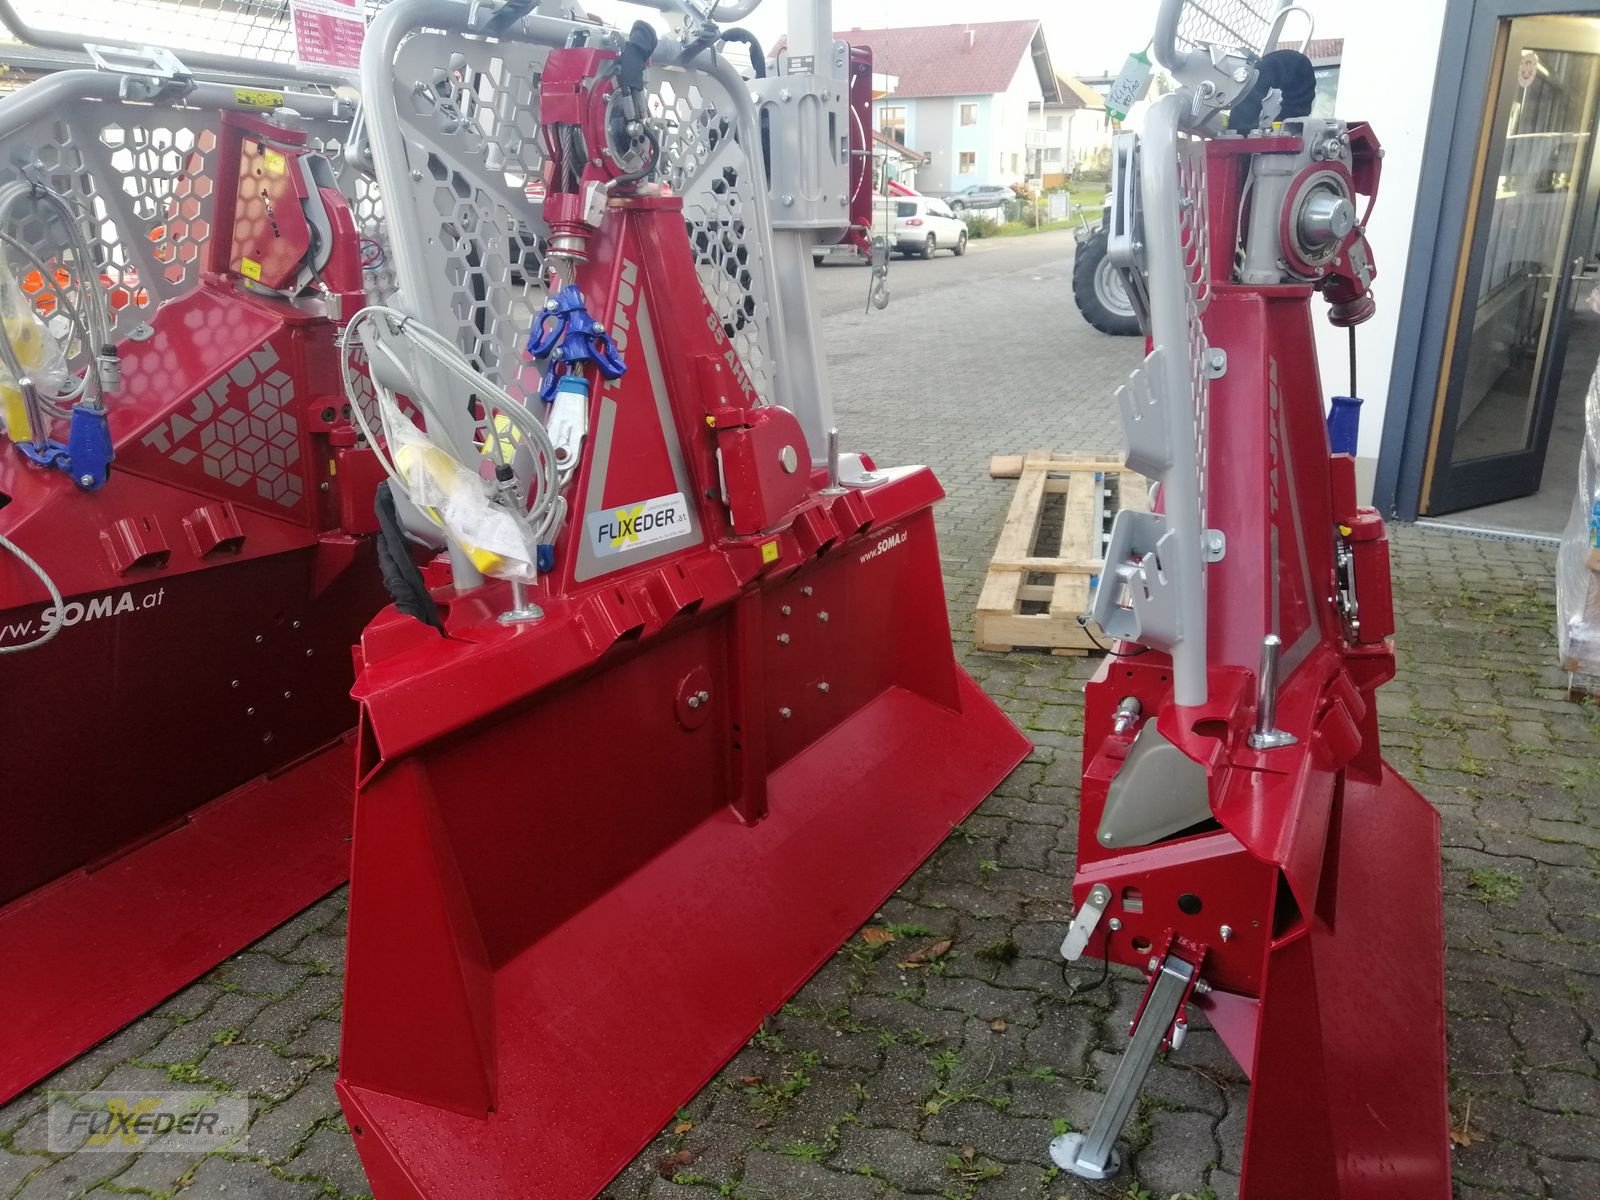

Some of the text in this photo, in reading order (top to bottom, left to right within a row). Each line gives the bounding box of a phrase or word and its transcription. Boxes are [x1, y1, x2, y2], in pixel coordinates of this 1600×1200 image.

[140, 340, 280, 454] TAJFUN
[707, 312, 753, 401] 85 AHK
